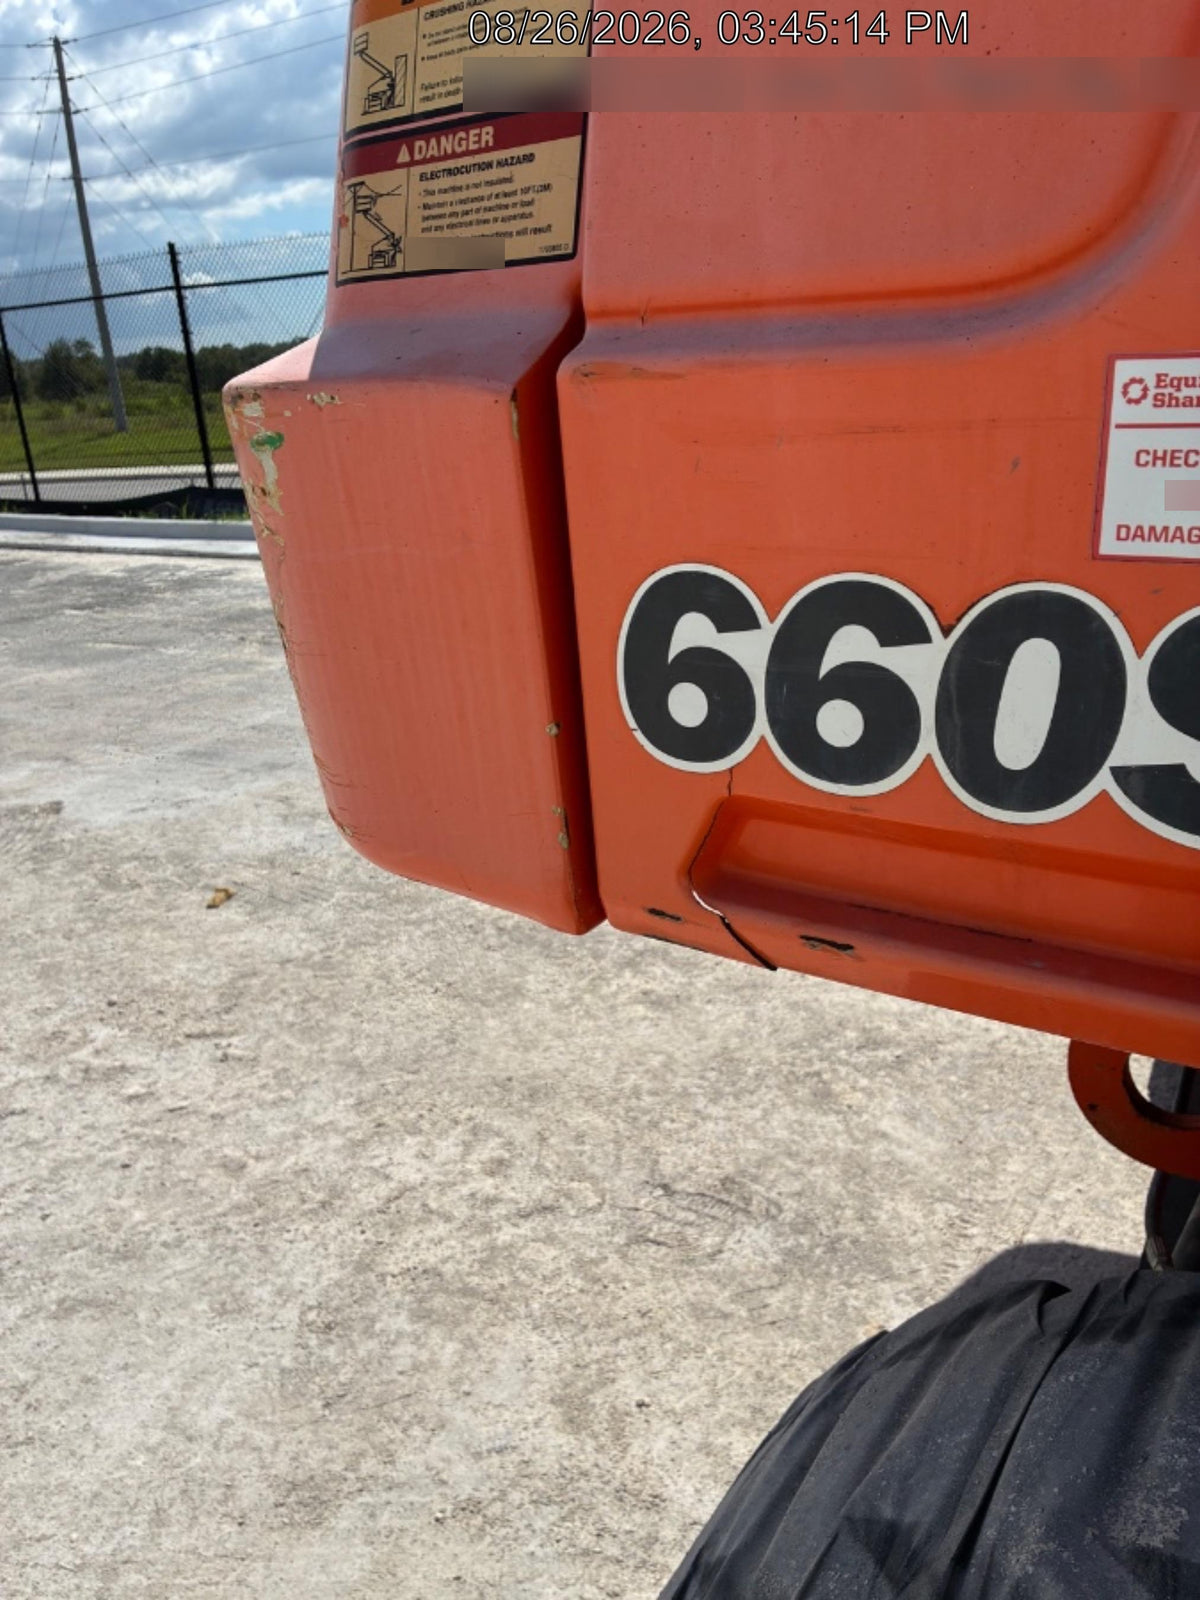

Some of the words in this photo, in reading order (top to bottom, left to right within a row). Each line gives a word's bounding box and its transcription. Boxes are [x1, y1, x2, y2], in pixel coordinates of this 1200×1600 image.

[413, 126, 495, 161] DANGER
[419, 160, 494, 181] ELECTROCUTION
[496, 153, 535, 168] HAZARD
[471, 180, 483, 191] not
[460, 207, 474, 219] part
[483, 201, 509, 214] machine
[515, 226, 529, 238] will
[529, 222, 553, 236] result
[1153, 372, 1200, 393] Equ
[1115, 523, 1200, 545] DAMAG
